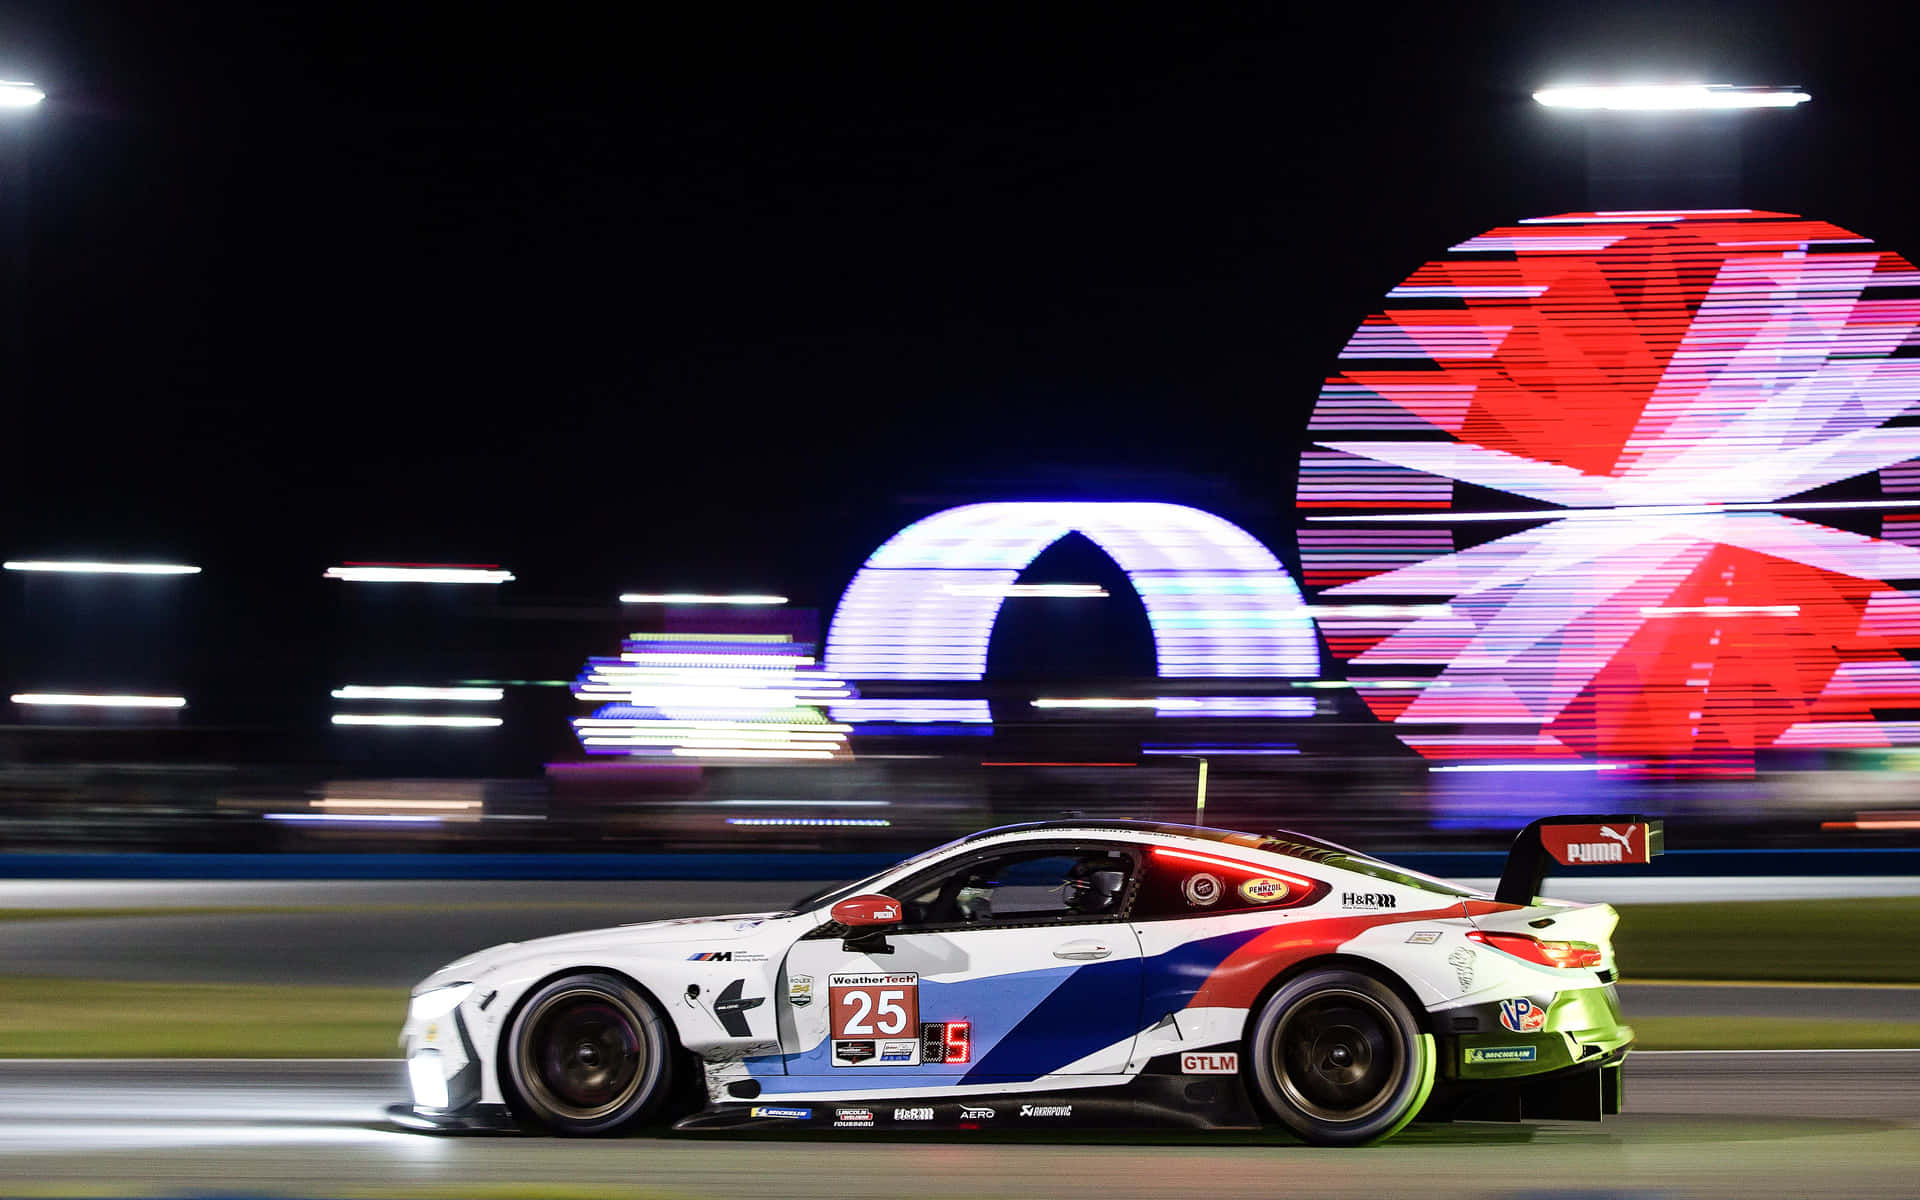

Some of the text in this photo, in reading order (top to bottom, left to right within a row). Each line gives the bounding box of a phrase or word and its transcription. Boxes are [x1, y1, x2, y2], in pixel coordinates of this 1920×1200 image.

[1567, 843, 1622, 861] PUMA
[1248, 884, 1282, 894] PENNZOIL
[832, 975, 915, 985] WeatherTech
[842, 990, 907, 1035] 25
[1502, 998, 1531, 1031] VP
[946, 1023, 969, 1063] 5
[1183, 1055, 1236, 1071] GTLM
[960, 1111, 995, 1119] AERO
